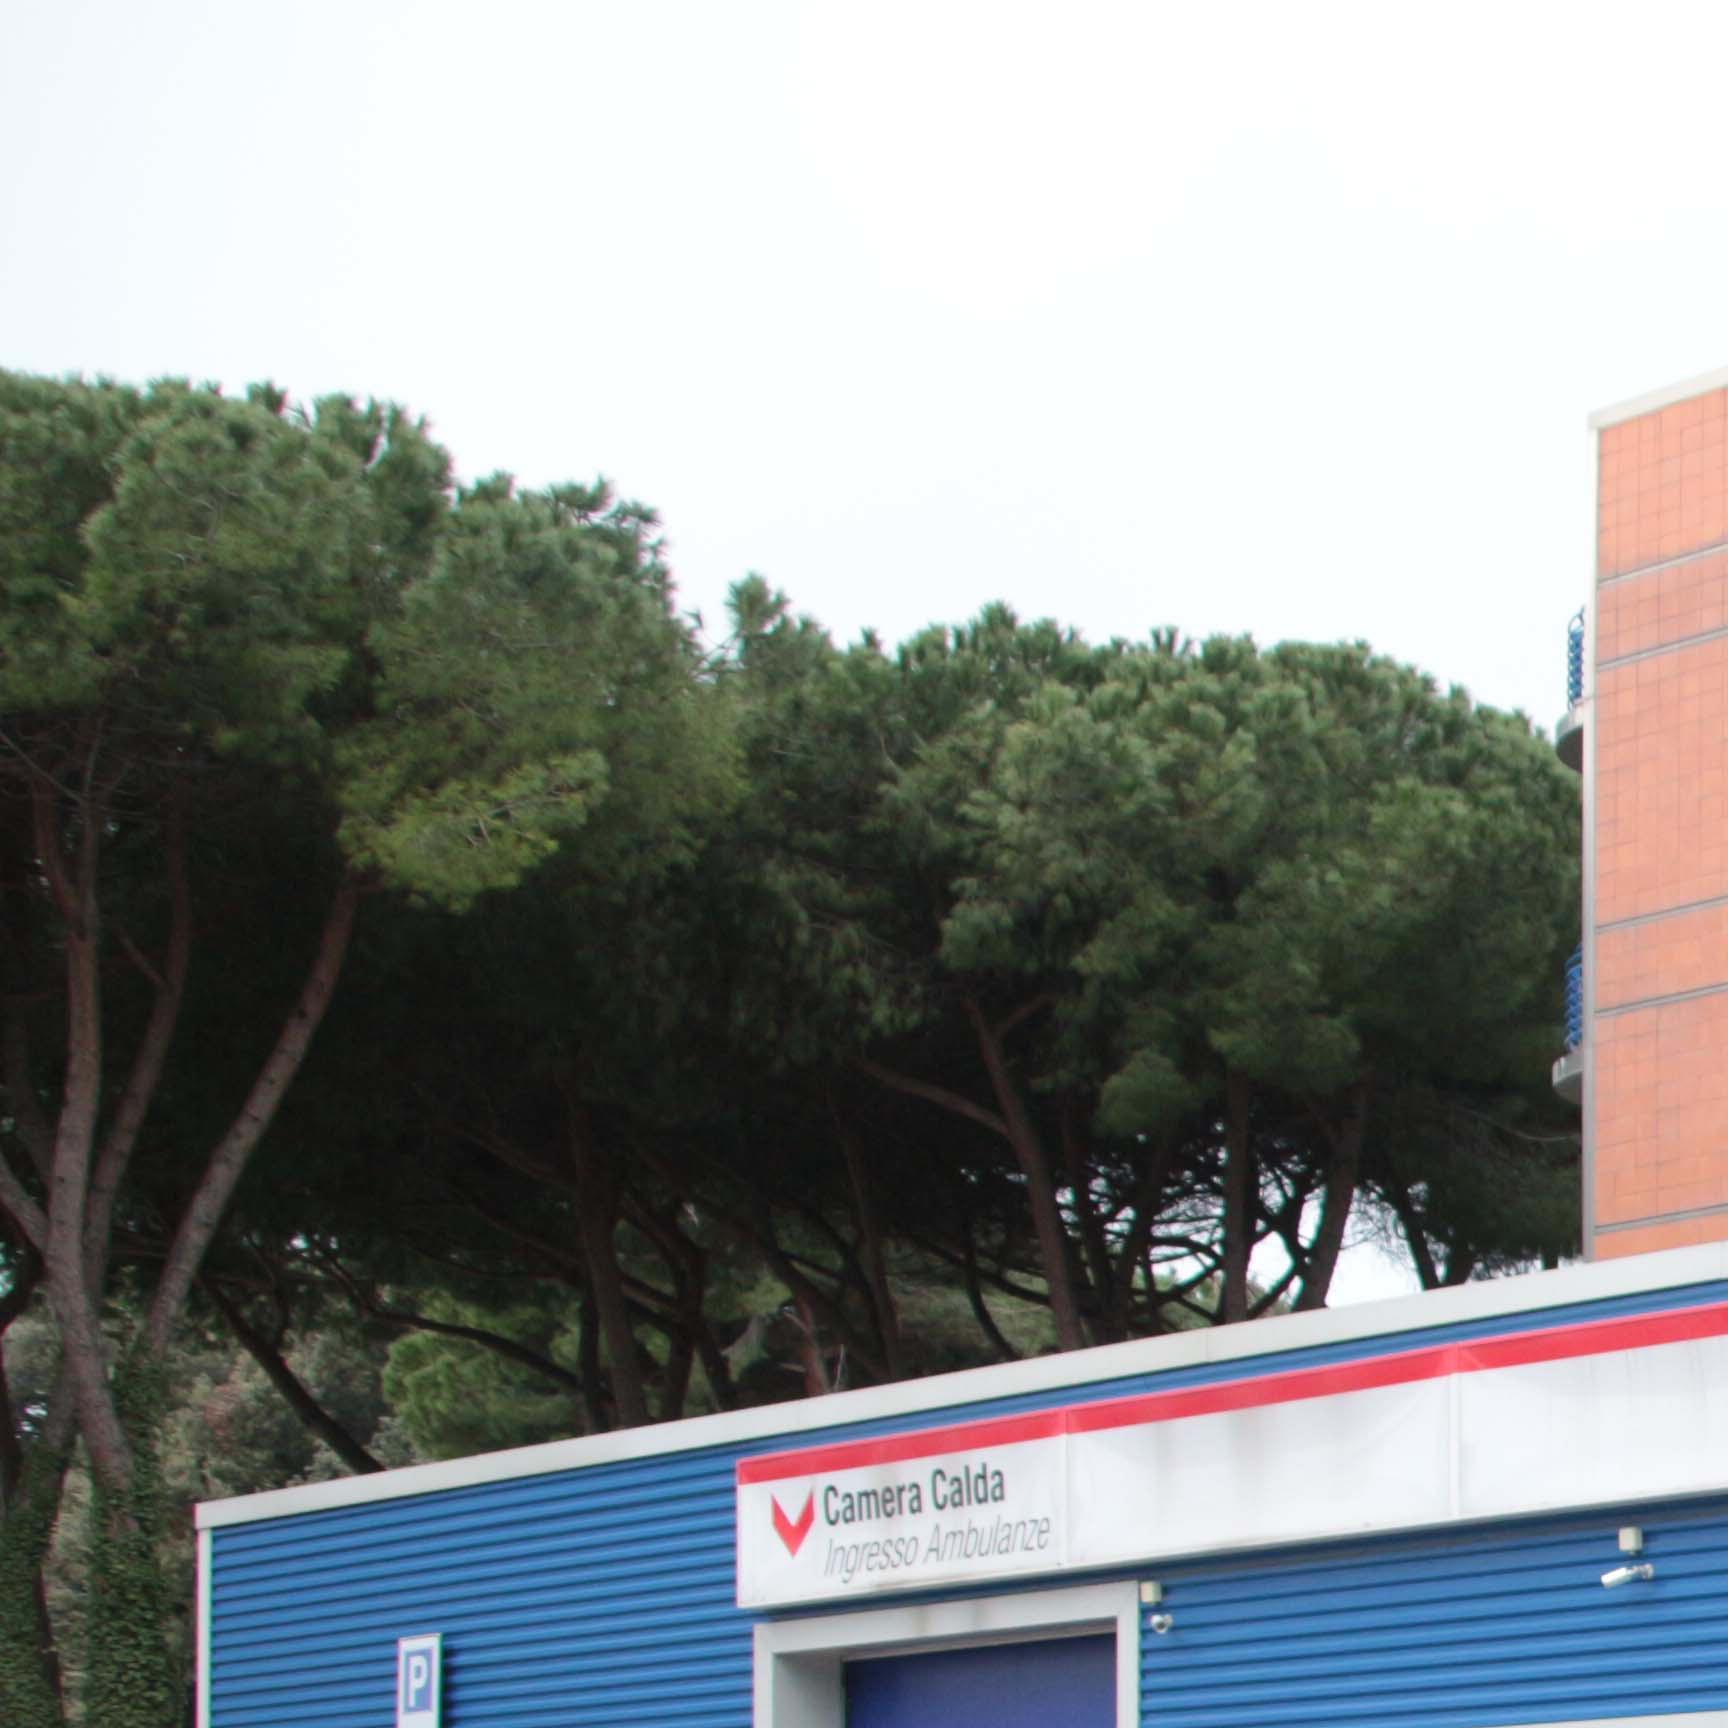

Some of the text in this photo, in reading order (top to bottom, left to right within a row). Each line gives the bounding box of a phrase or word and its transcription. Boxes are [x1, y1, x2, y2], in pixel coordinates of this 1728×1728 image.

[823, 1463, 1005, 1526] Camera Calda
[824, 1514, 1051, 1583] Ingresso Ambulanze
[408, 1655, 428, 1707] P
